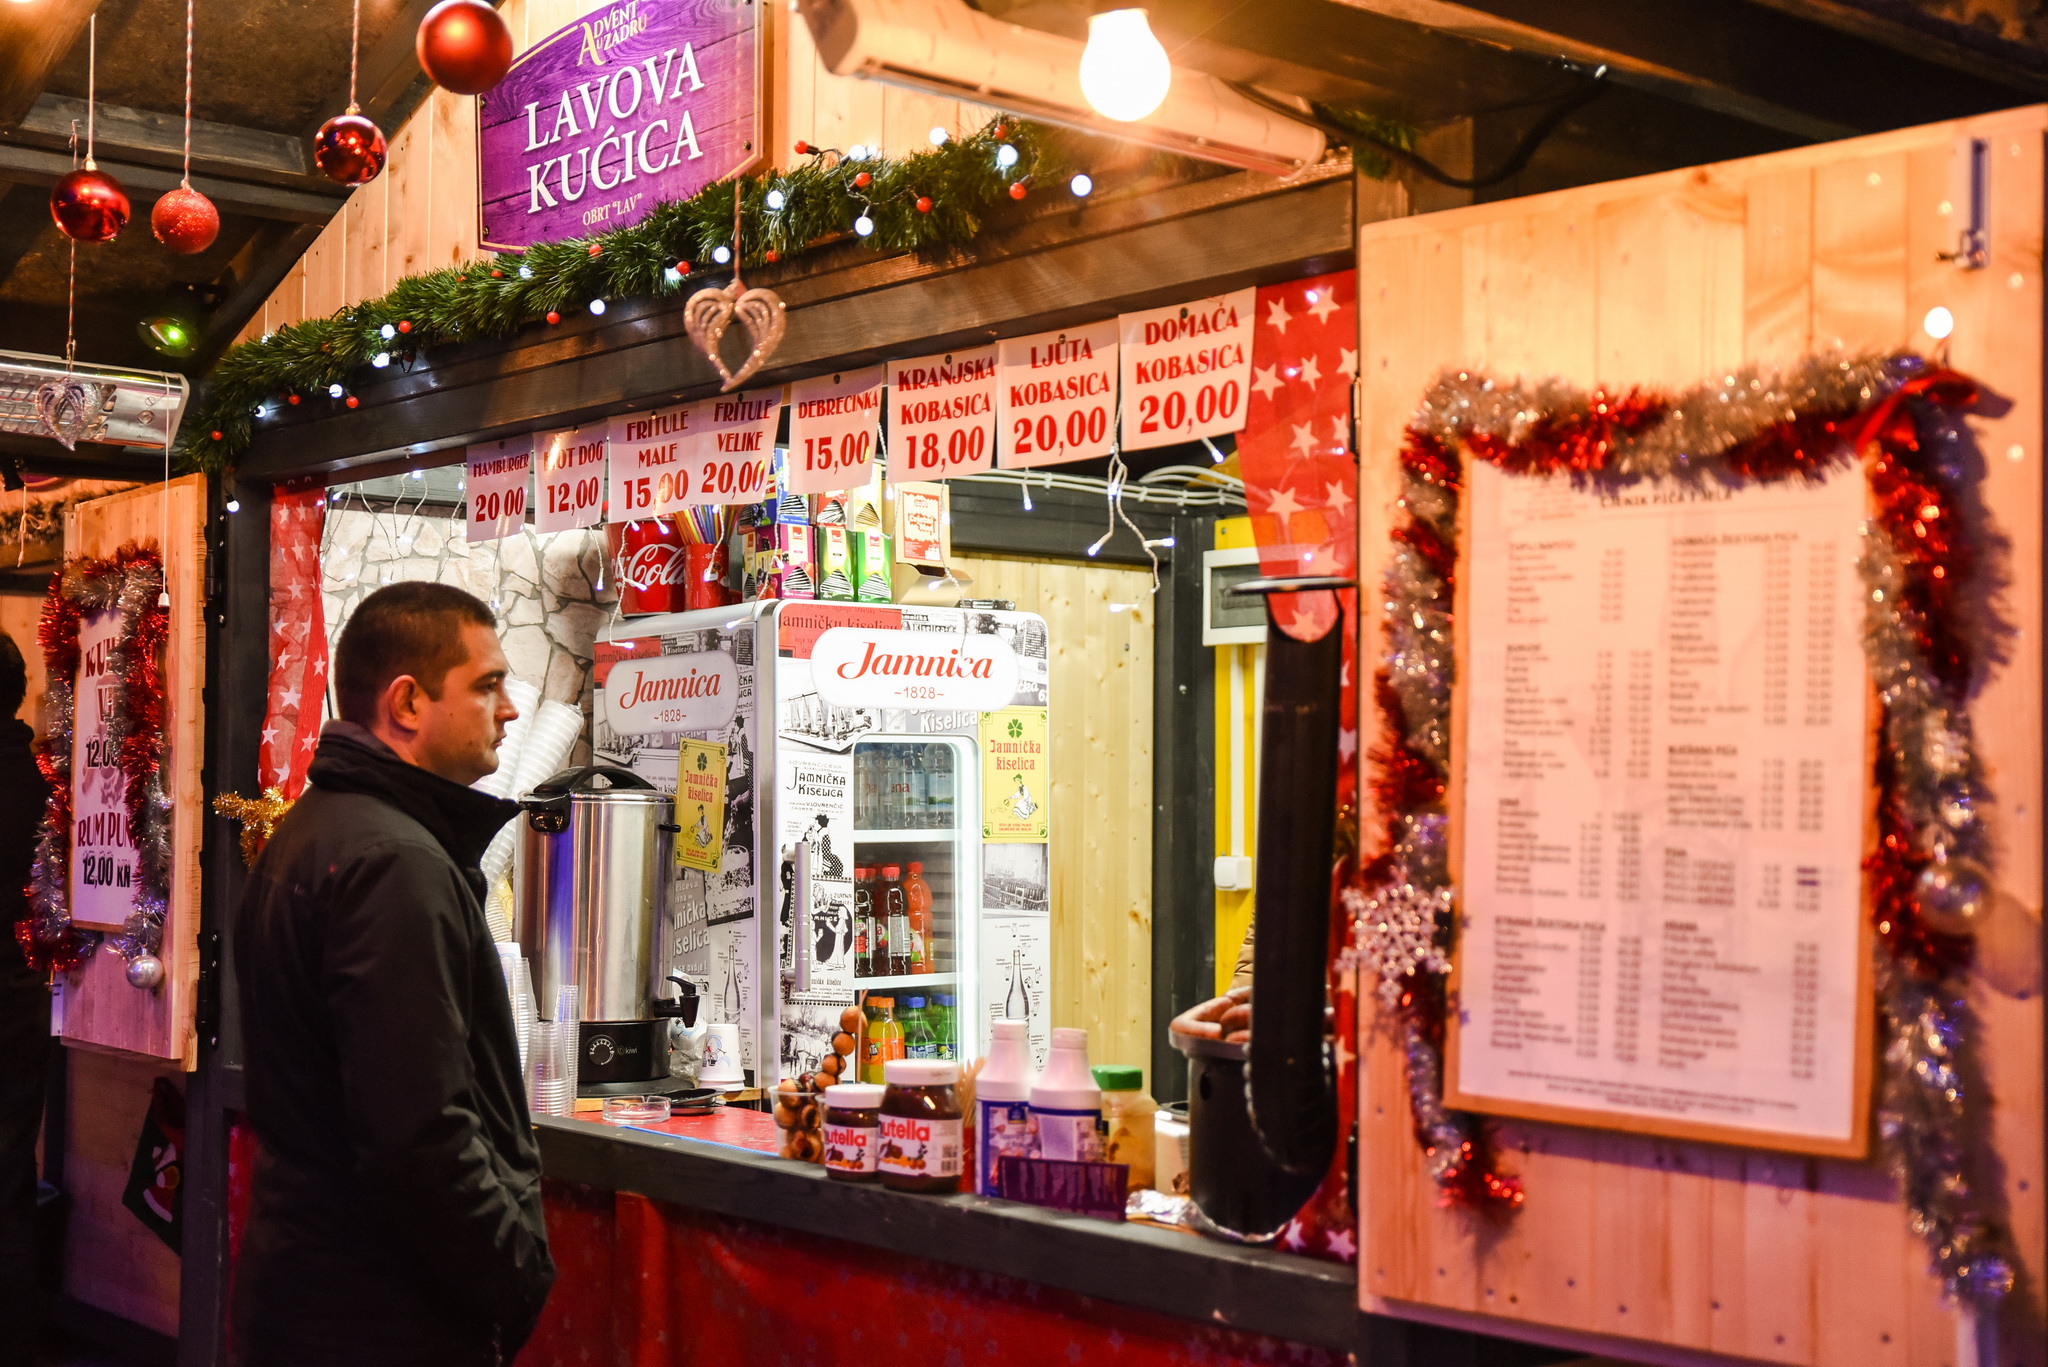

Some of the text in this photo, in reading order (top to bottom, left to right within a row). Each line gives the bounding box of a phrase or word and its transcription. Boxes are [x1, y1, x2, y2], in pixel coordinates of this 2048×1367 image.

[577, 2, 639, 66] ADVENT
[604, 15, 647, 49] ZADRU
[525, 42, 704, 151] LAVOVA
[527, 110, 703, 214] KUĆICA
[583, 204, 610, 226] OBRT
[898, 356, 996, 392] KRANJSKA
[1136, 343, 1244, 385] KOBASICA
[798, 390, 879, 419] DEBRECINKA
[1010, 371, 1110, 408] KOBASICA
[1139, 380, 1239, 433] 20,00
[713, 399, 773, 422] FRITULE
[901, 391, 991, 425] KOBASICA
[626, 410, 689, 441] FRITULE
[717, 431, 763, 453] VELIKE
[1014, 406, 1106, 455] 20,00
[473, 453, 529, 478] HAMBURGER
[578, 440, 603, 464] DOG
[638, 443, 678, 469] MALE
[804, 430, 870, 475] 15,00
[906, 425, 985, 473] 18,00
[547, 476, 599, 516] 12,00
[701, 459, 765, 499] 20,00
[475, 486, 524, 522] 2000
[836, 641, 993, 679] Jamnica
[619, 668, 721, 710] Jamnica
[920, 710, 978, 733] Kiselica
[990, 740, 1041, 754] Jamnička
[996, 757, 1035, 770] kiselica
[684, 770, 719, 789] Jamnička
[688, 786, 713, 803] kiselica
[786, 767, 846, 791] JAMNIČKA
[798, 783, 843, 797] KISELICA
[78, 812, 105, 847] RUM
[83, 855, 113, 888] 12,00
[674, 899, 707, 931] nička
